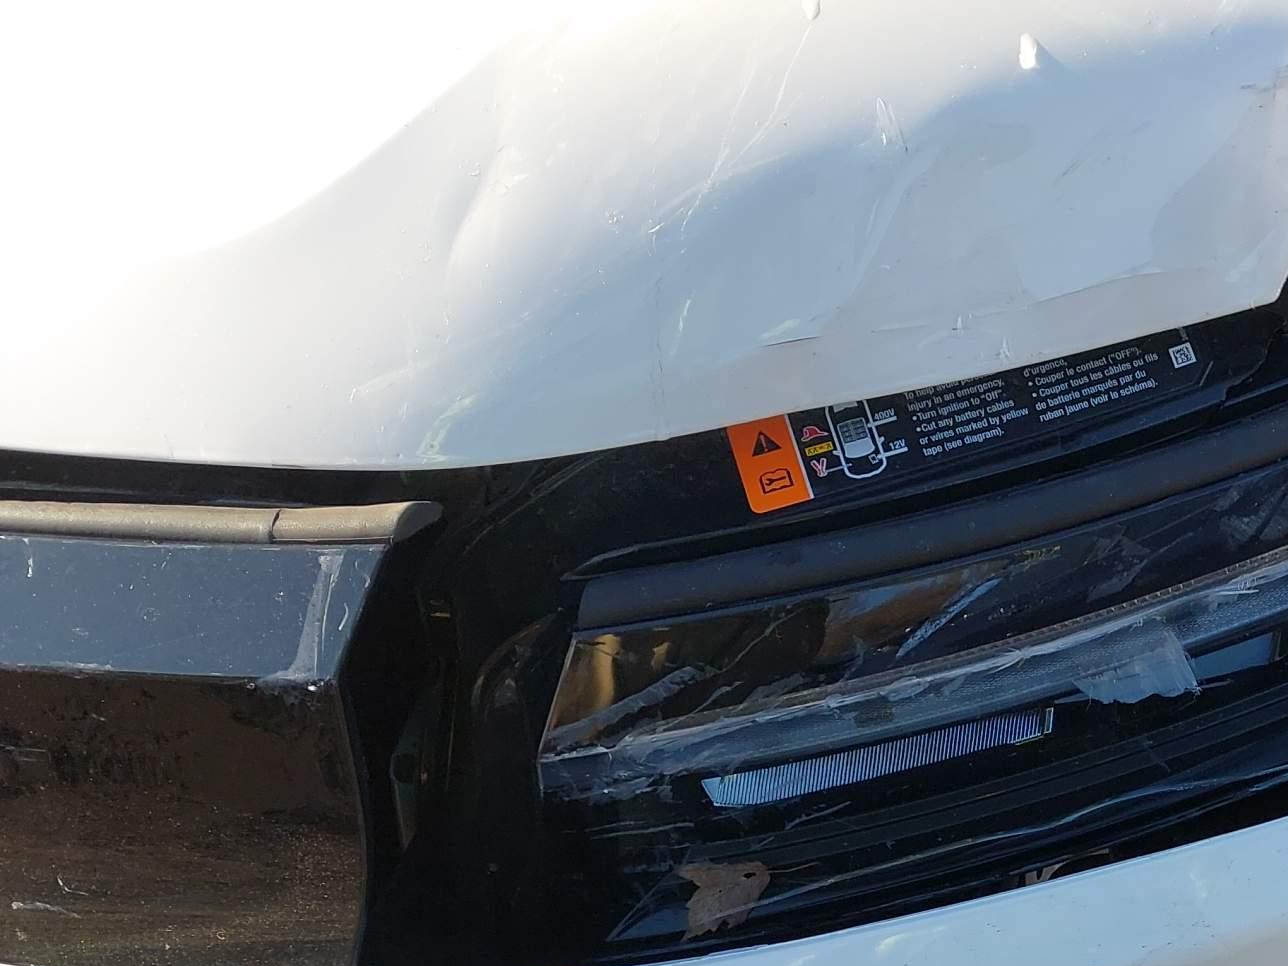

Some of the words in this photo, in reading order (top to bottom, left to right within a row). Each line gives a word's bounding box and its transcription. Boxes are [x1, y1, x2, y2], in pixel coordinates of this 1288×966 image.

[1035, 370, 1064, 386] Couper
[1065, 367, 1074, 377] le
[1076, 357, 1107, 373] contact
[1039, 382, 1069, 397] Couper
[1070, 376, 1089, 388] tous
[1090, 370, 1102, 381] les
[1104, 362, 1131, 376] câbles
[1133, 358, 1144, 368] ou
[1144, 352, 1158, 364] fils
[933, 395, 942, 404] in
[944, 392, 955, 401] an
[1035, 402, 1046, 411] de
[1047, 391, 1080, 407] batterie
[1082, 379, 1118, 396] marqués
[1119, 375, 1133, 387] par
[1134, 369, 1146, 379] du
[873, 408, 895, 420] 400V
[921, 421, 938, 432] Cut
[938, 416, 954, 427] any
[955, 406, 985, 423] battery
[987, 400, 1015, 413] cables
[938, 401, 970, 416] ignition
[970, 396, 980, 406] to
[1039, 408, 1064, 423] ruban
[1065, 402, 1089, 416] jaune
[1090, 394, 1109, 408] (voir
[1109, 391, 1119, 401] le
[919, 436, 929, 445] or
[930, 429, 955, 442] wires
[956, 418, 988, 434] marked
[989, 415, 1000, 426] by
[1002, 407, 1029, 422] yellow
[888, 439, 905, 450] 12V
[923, 445, 943, 456] tape
[944, 439, 962, 452] (see
[964, 427, 1005, 444] diagram).
